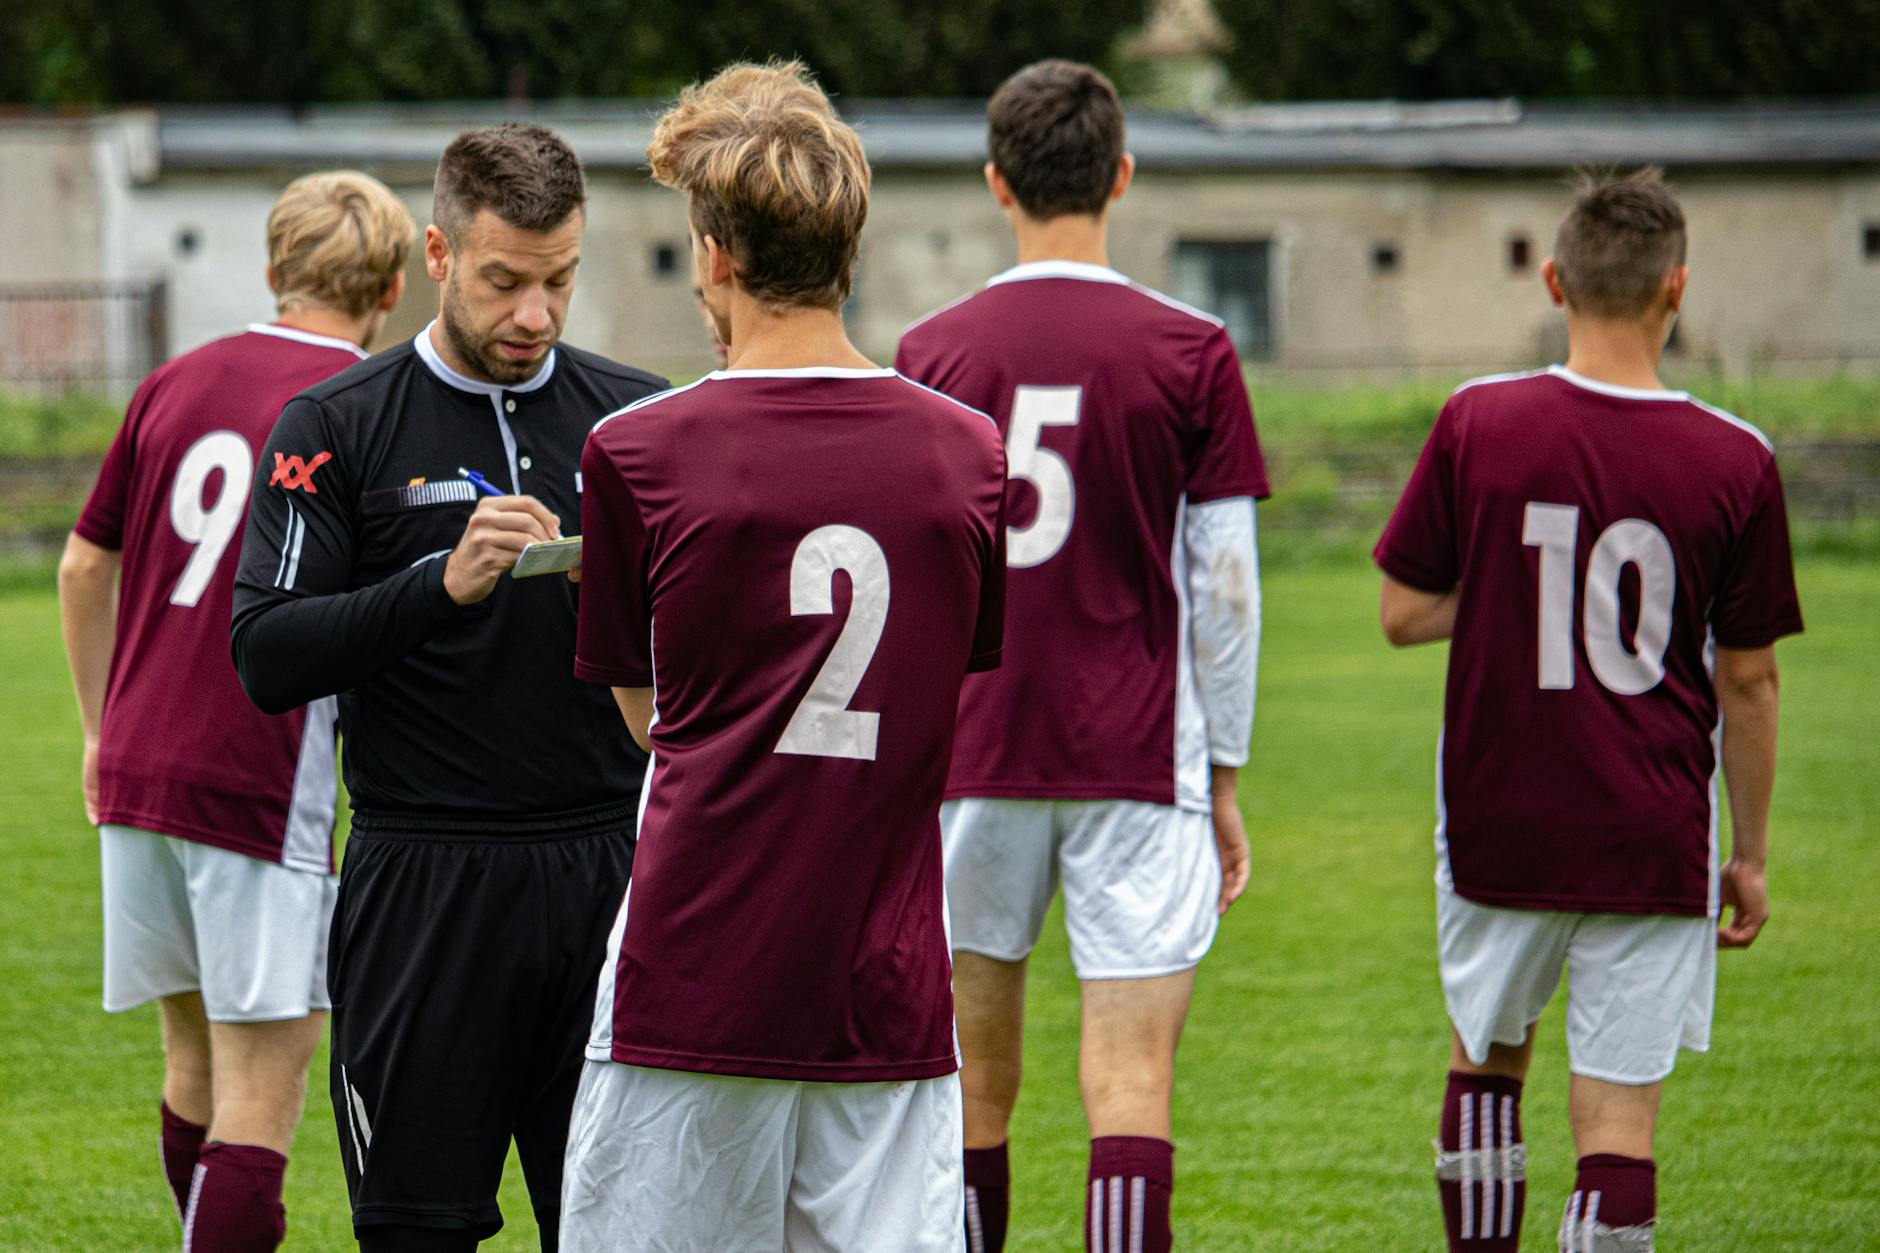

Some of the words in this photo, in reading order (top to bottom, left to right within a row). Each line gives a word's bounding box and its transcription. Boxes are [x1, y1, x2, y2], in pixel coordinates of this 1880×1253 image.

[169, 429, 254, 608] 9
[1004, 384, 1083, 568] 5
[773, 523, 892, 762] 2
[1521, 502, 1676, 696] 10
